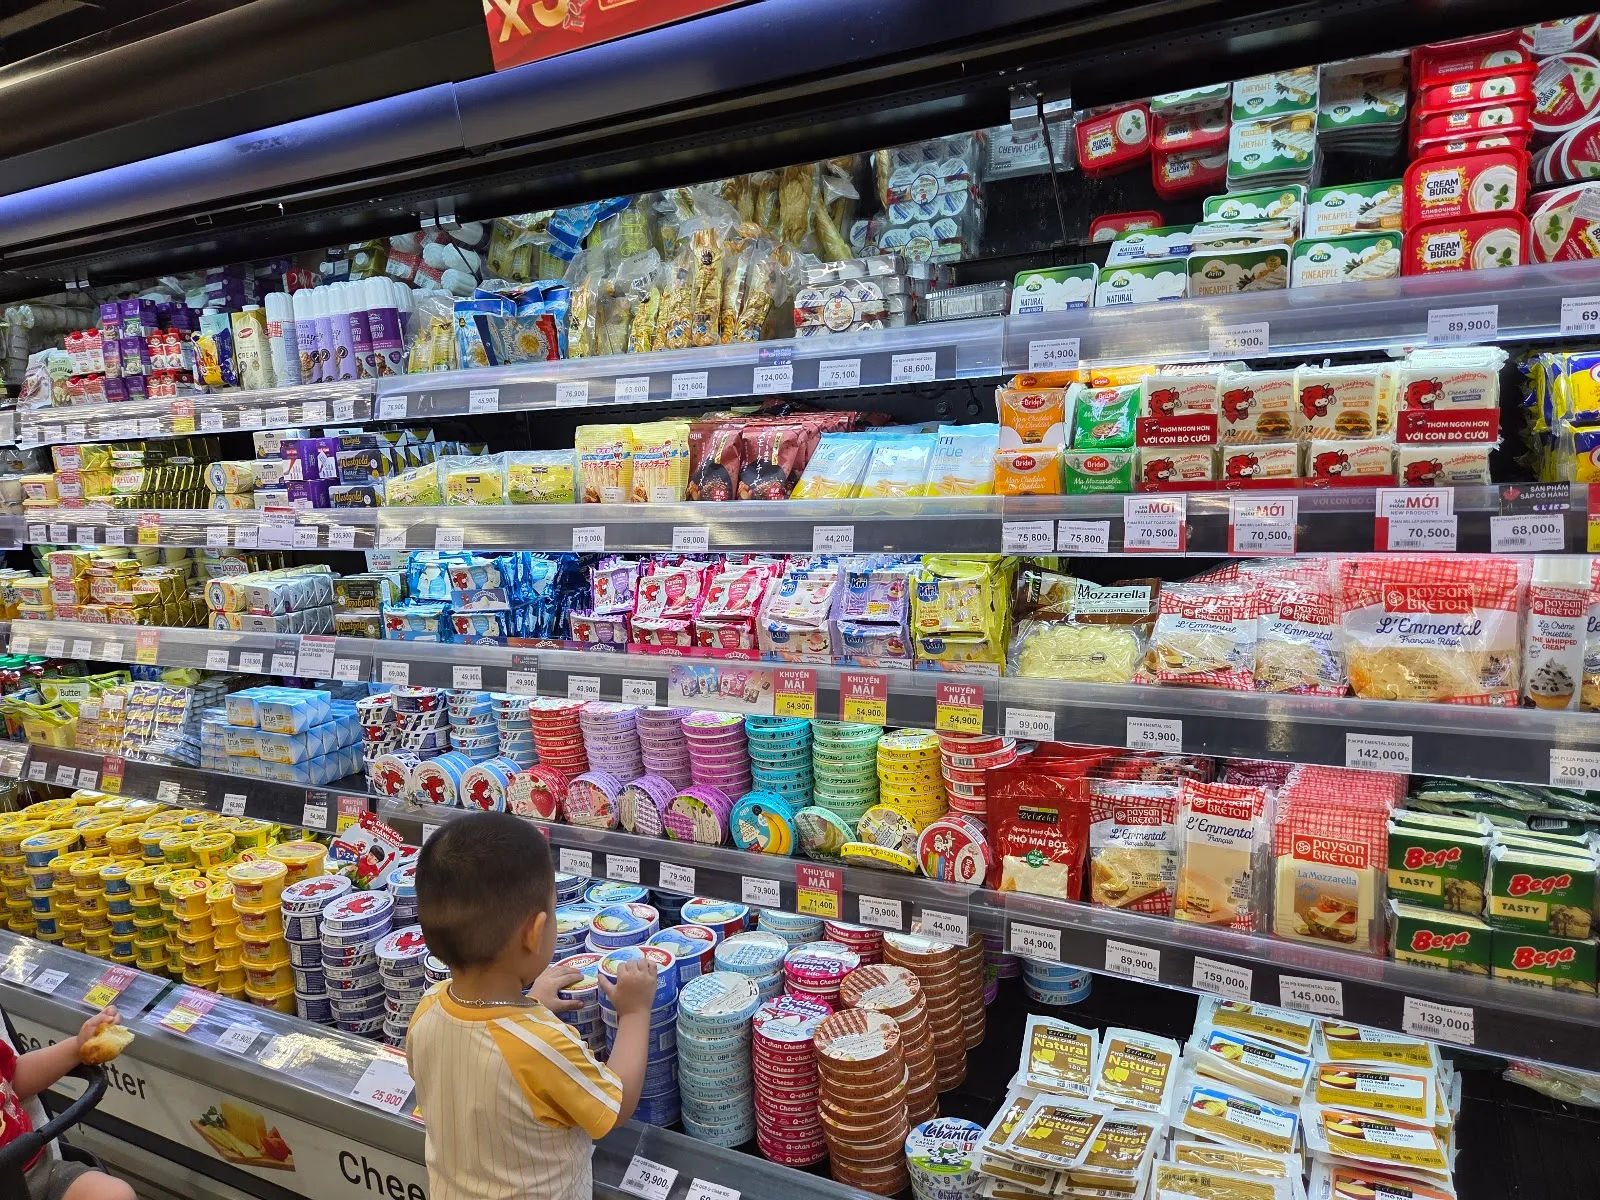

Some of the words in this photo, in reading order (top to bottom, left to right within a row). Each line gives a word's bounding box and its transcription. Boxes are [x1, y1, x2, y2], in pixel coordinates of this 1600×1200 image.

[1426, 177, 1459, 190] CREAM
[1429, 186, 1455, 197] BURG
[1327, 199, 1343, 207] Arla
[1317, 212, 1353, 221] PINEAPPLE
[1427, 239, 1460, 251] CREAM
[1312, 253, 1329, 261] Arla
[1430, 249, 1457, 259] BURG
[1207, 270, 1223, 279] Arla
[1301, 268, 1338, 279] PINEAPPLE
[1027, 282, 1041, 291] Arla
[1113, 279, 1129, 287] Arla
[1020, 297, 1044, 306] NATURAL
[1106, 293, 1133, 304] NATURAL
[1451, 372, 1477, 382] Laughing
[1449, 420, 1471, 428] NGON
[1426, 432, 1446, 440] CON
[934, 446, 963, 458] true
[1016, 459, 1033, 467] Bridel
[1087, 460, 1106, 468] Bridel
[1406, 494, 1439, 508] MỚI
[1256, 503, 1285, 517] MỚI
[851, 577, 867, 588] Kiri
[1077, 584, 1146, 599] Mozzarella
[1407, 586, 1474, 602] paysan
[1408, 597, 1474, 612] BRETON
[1545, 600, 1581, 609] paysan
[1545, 606, 1580, 616] BRETON
[1376, 617, 1482, 637] L'Emmental
[1538, 620, 1549, 629] La
[1554, 621, 1575, 630] Crème
[1546, 637, 1578, 645] WHIPPED
[60, 689, 81, 697] Butter
[1127, 809, 1159, 818] paysan
[1206, 804, 1249, 819] BRETON
[1126, 816, 1159, 825] BRETON
[1110, 828, 1166, 841] L'Emmental
[1207, 833, 1234, 845] Français
[1029, 837, 1046, 847] MAI
[1313, 840, 1364, 854] paysan
[1312, 850, 1364, 866] BRETON
[1403, 847, 1462, 871] Bega
[809, 877, 830, 889] MÃI
[1297, 870, 1308, 879] La
[1308, 871, 1357, 886] Mozzarella
[1399, 876, 1435, 888] TASTY
[1507, 874, 1572, 897] Bega
[1502, 903, 1540, 914] TASTY
[1411, 930, 1470, 952] Bega
[1512, 946, 1576, 970] Bega
[819, 977, 841, 985] Cheese
[781, 995, 827, 1013] Q-chan
[777, 1002, 823, 1018] Cheese
[696, 1026, 730, 1035] VANILLA
[709, 1042, 735, 1051] Dessert
[761, 1038, 782, 1049] Q-chan
[783, 1042, 806, 1050] Cheese
[1033, 1038, 1088, 1056] Natural
[1060, 1038, 1088, 1047] CHEDDAR
[786, 1054, 811, 1062] Q-chan
[1137, 1057, 1166, 1067] CHEDDAR
[703, 1066, 728, 1074] Dessert
[772, 1065, 795, 1073] Cheese
[1108, 1055, 1166, 1076] Natural
[102, 1062, 147, 1101] tter
[772, 1078, 794, 1086] Cheese
[372, 1089, 403, 1107] 25,900
[698, 1090, 723, 1098] Dessert
[790, 1090, 813, 1099] Q-chan
[760, 1096, 778, 1110] Q-chan
[779, 1103, 802, 1112] Cheese
[714, 1114, 739, 1123] Dessert
[793, 1116, 817, 1125] Q-chan
[1034, 1117, 1093, 1135] Natural
